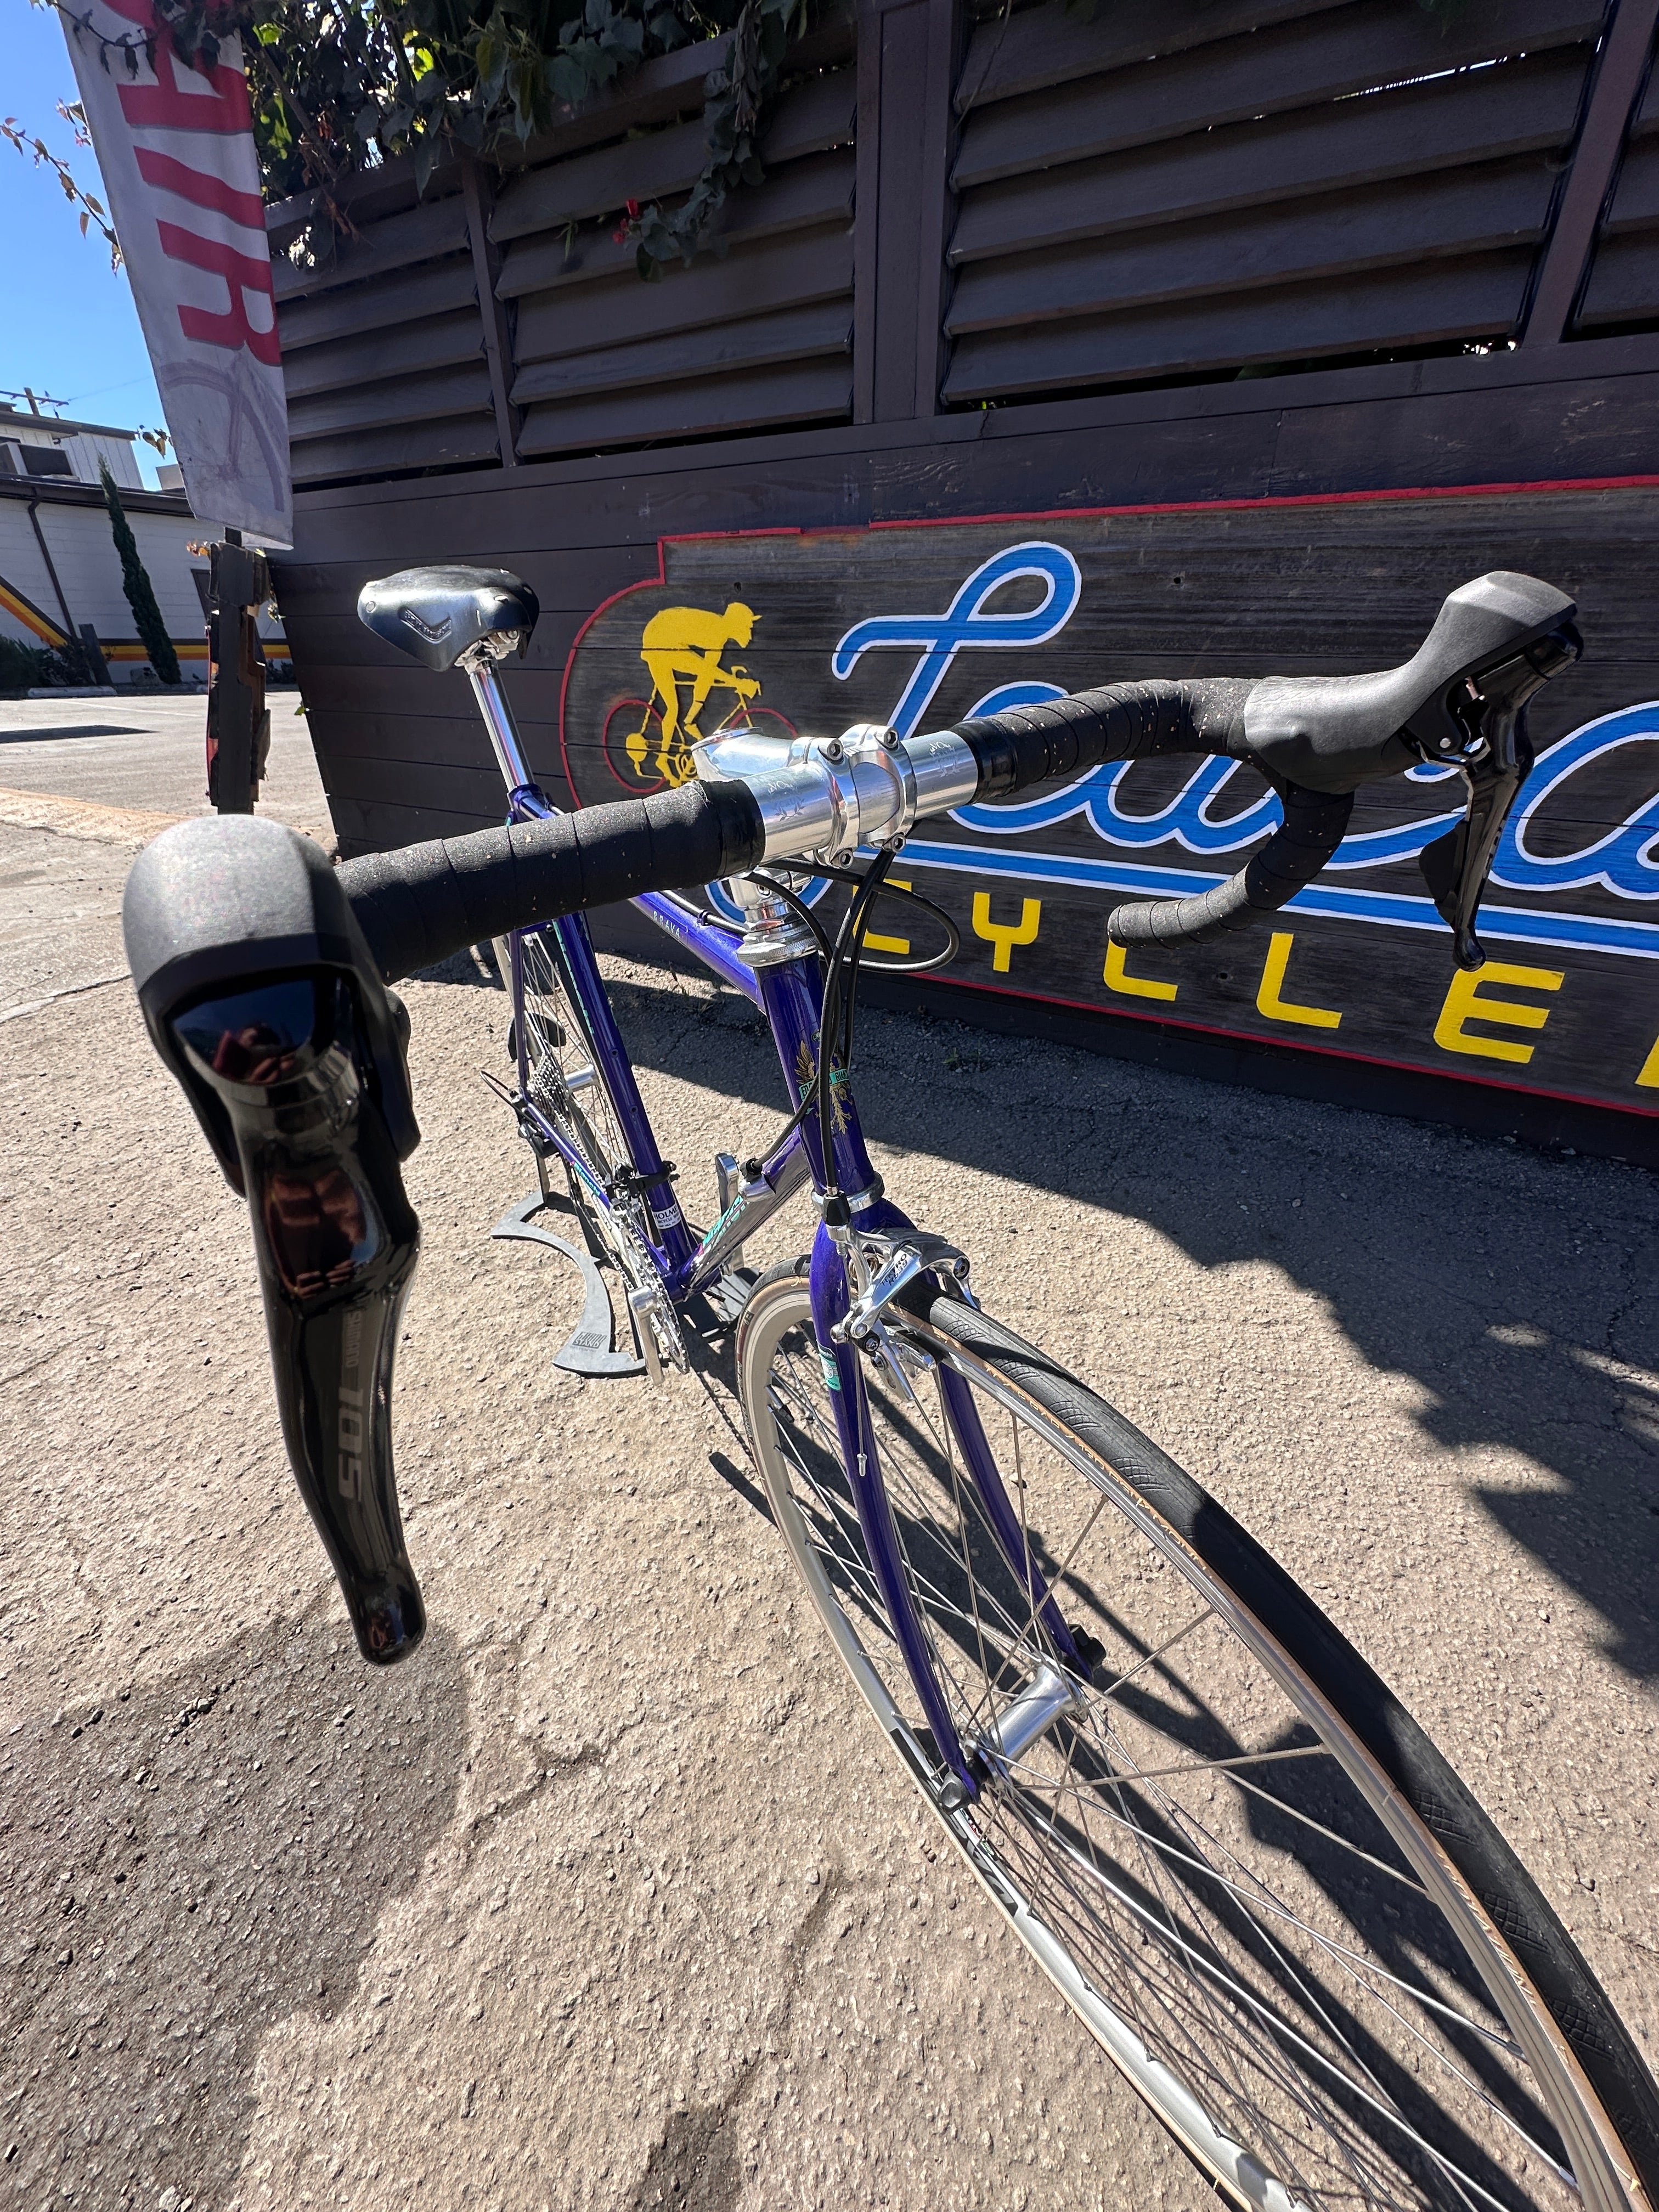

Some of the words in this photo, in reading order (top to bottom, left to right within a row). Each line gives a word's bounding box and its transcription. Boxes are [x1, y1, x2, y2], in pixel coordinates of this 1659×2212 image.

[104, 0, 282, 366] AIR
[653, 910, 680, 938] BRAVA
[853, 877, 1659, 1088] CYCLE
[882, 1253, 907, 1286] TEKTRO
[345, 1310, 362, 1369] SHIMANO
[574, 1339, 600, 1348] STAND
[337, 1387, 364, 1503] 105
